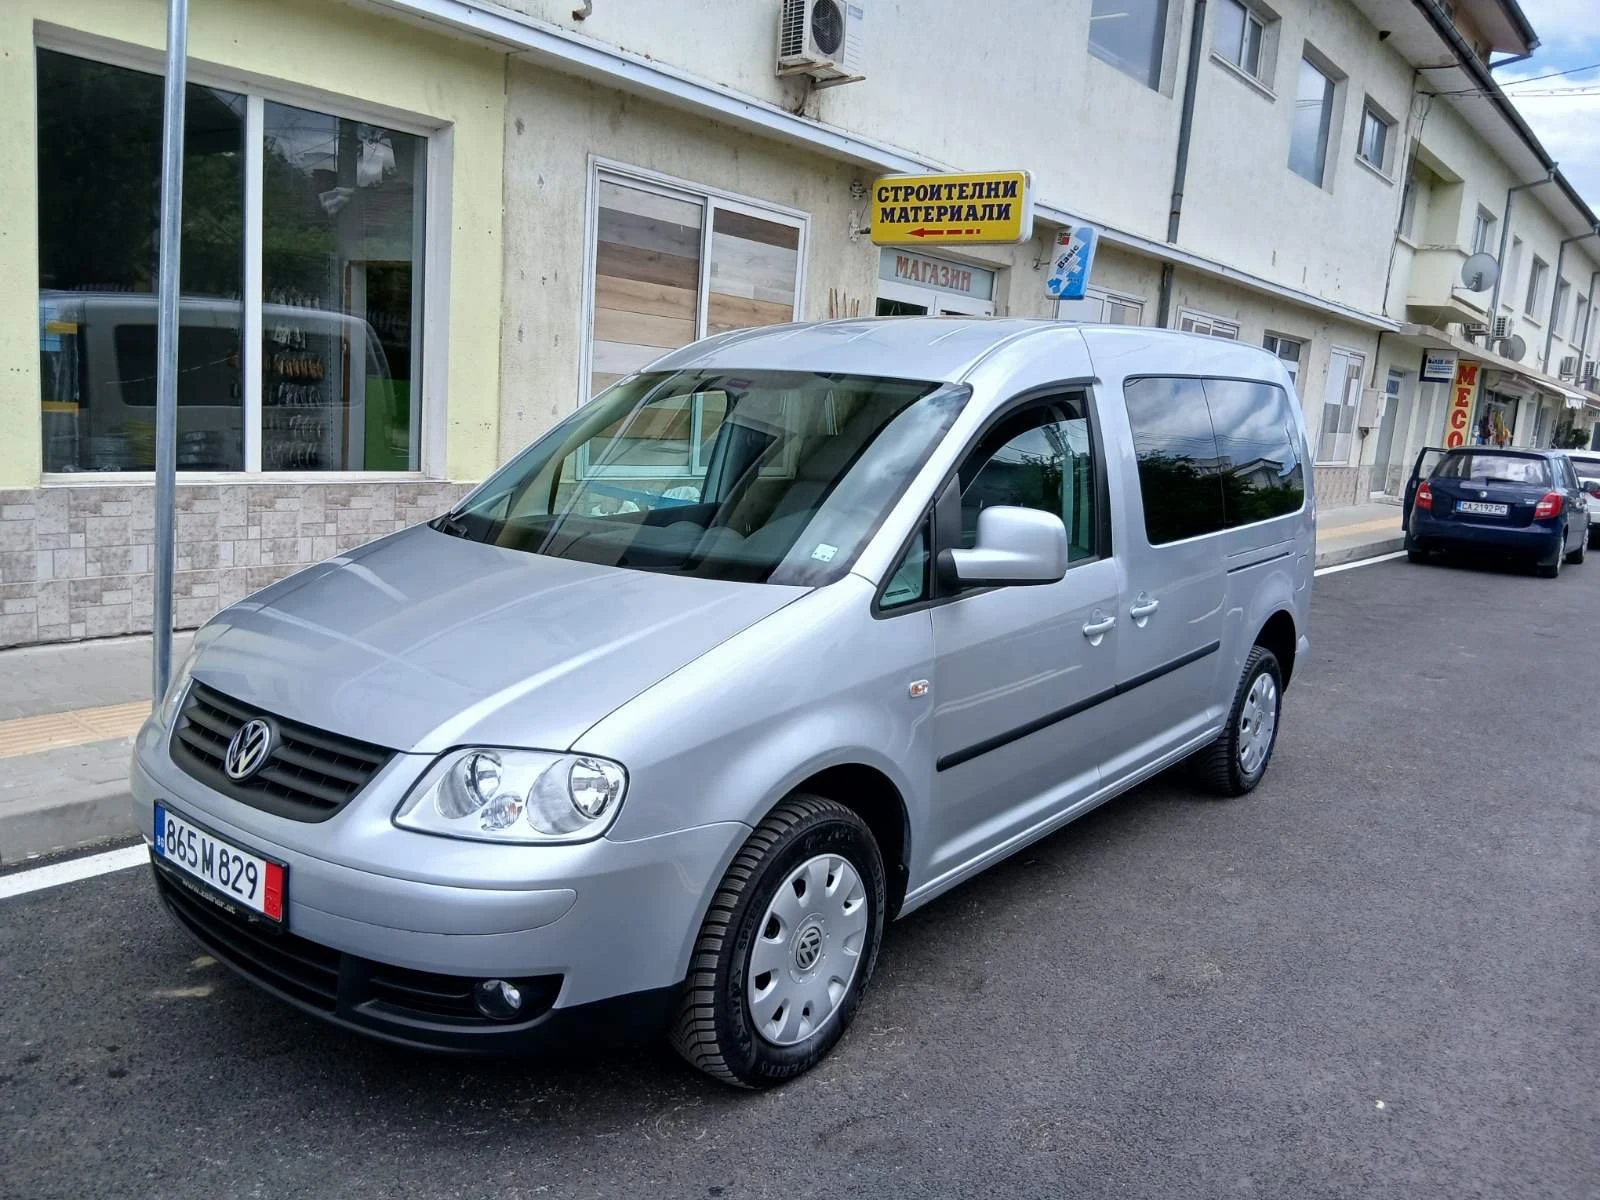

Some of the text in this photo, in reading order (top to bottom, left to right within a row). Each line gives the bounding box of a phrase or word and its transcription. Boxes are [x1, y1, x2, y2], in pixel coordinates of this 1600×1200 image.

[877, 180, 1018, 203] СТРОИТЕЛНИ
[879, 203, 1012, 224] МАТЕРИАЛИ
[1057, 245, 1079, 269] Basic
[895, 255, 972, 292] МАГАЗИН
